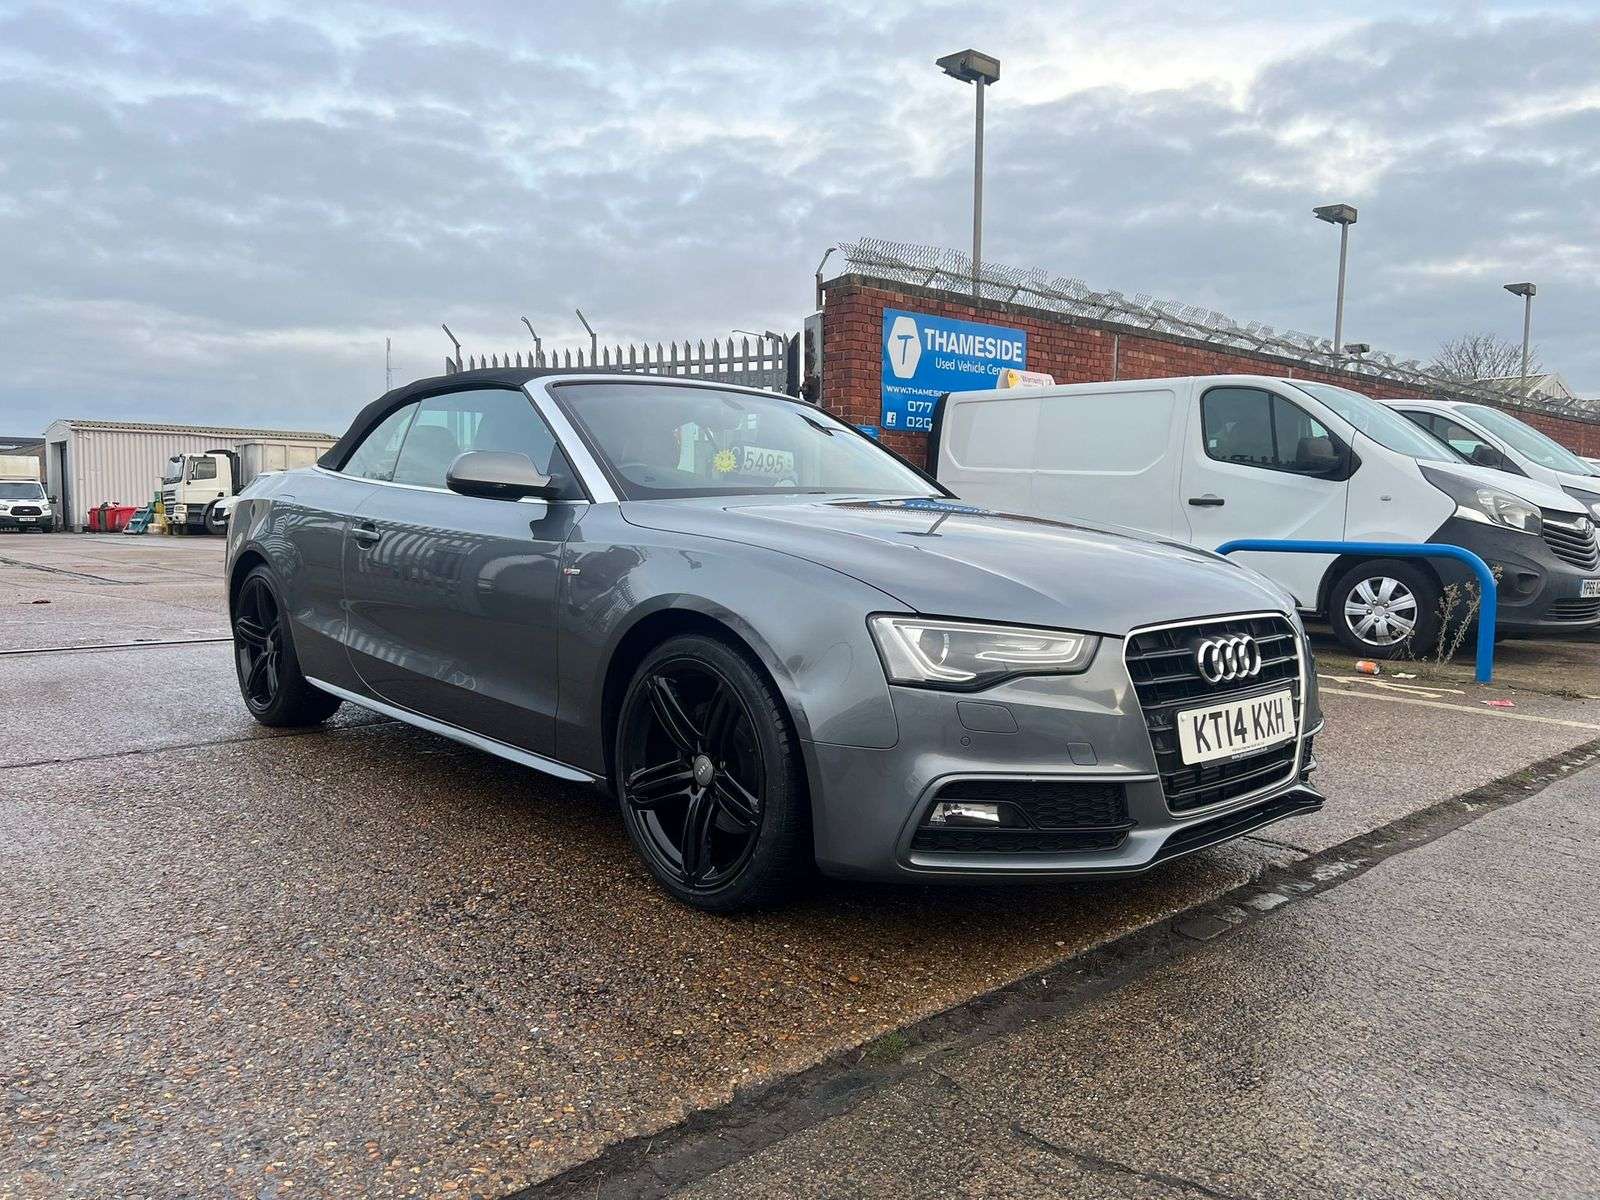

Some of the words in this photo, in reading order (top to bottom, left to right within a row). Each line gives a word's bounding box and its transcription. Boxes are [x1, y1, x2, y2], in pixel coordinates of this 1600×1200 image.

[924, 328, 1023, 362] THAMESIDE
[935, 357, 956, 370] Used
[957, 360, 985, 375] Vehicle
[907, 400, 932, 413] 077
[1193, 707, 1248, 754] KT14
[1251, 698, 1286, 740] KXH
